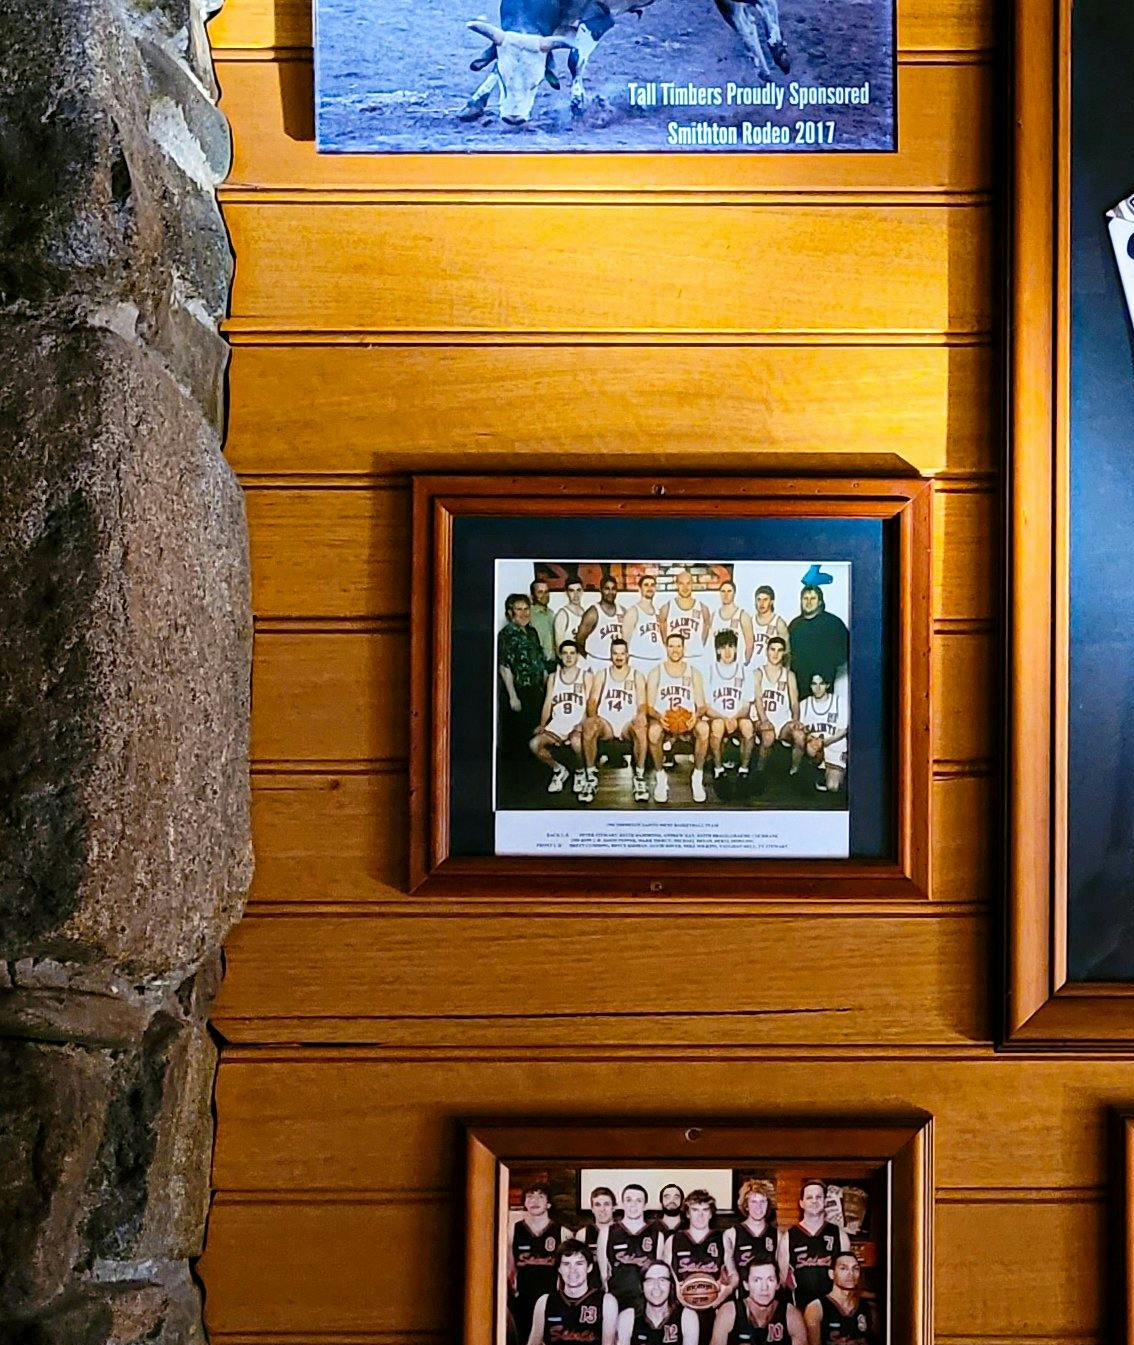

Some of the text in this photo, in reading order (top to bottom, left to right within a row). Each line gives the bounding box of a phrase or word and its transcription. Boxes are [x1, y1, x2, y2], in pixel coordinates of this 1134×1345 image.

[628, 82, 870, 110] Tall Timbers Proudly Sponsored
[667, 121, 835, 145] Smithton Rodeo 2017
[608, 700, 622, 712] 14
[722, 698, 735, 710] 13
